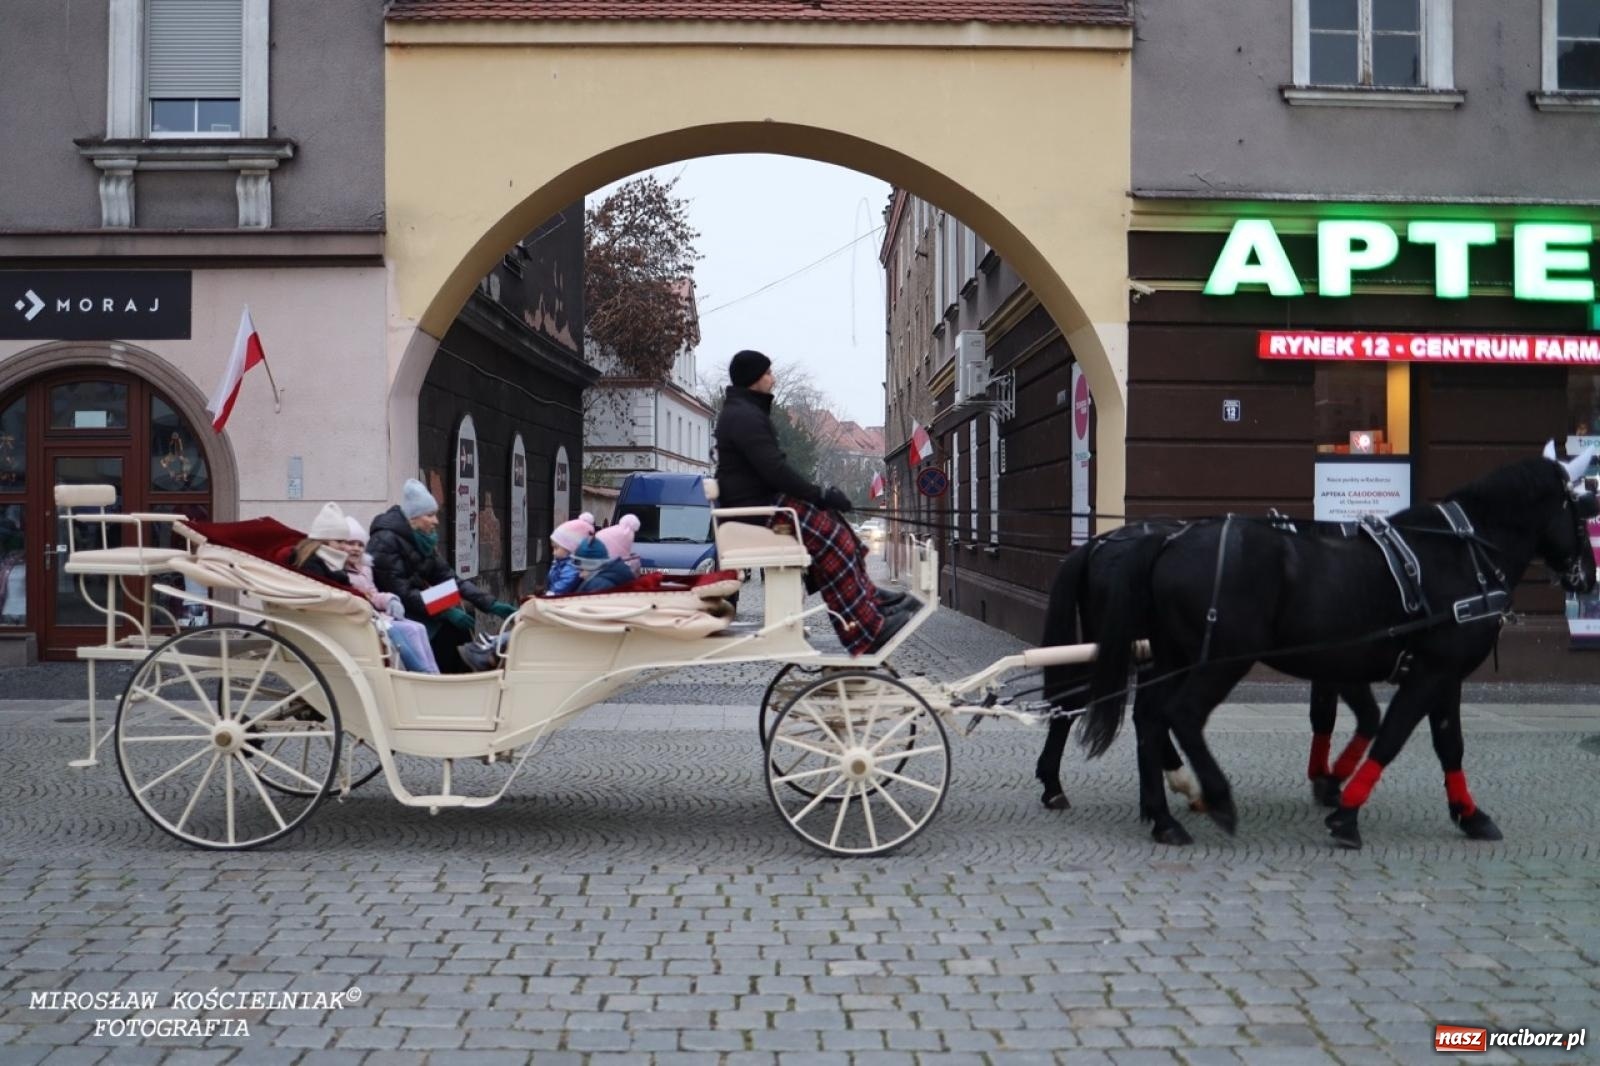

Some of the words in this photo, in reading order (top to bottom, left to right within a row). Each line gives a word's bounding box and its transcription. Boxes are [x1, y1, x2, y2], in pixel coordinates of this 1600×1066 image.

[1202, 219, 1596, 301] APTE
[56, 298, 160, 313] MORAJ
[1269, 335, 1355, 356] RYNEK
[1361, 337, 1390, 356] 12
[1409, 337, 1529, 360] CENTRUM
[1534, 339, 1600, 362] FARM
